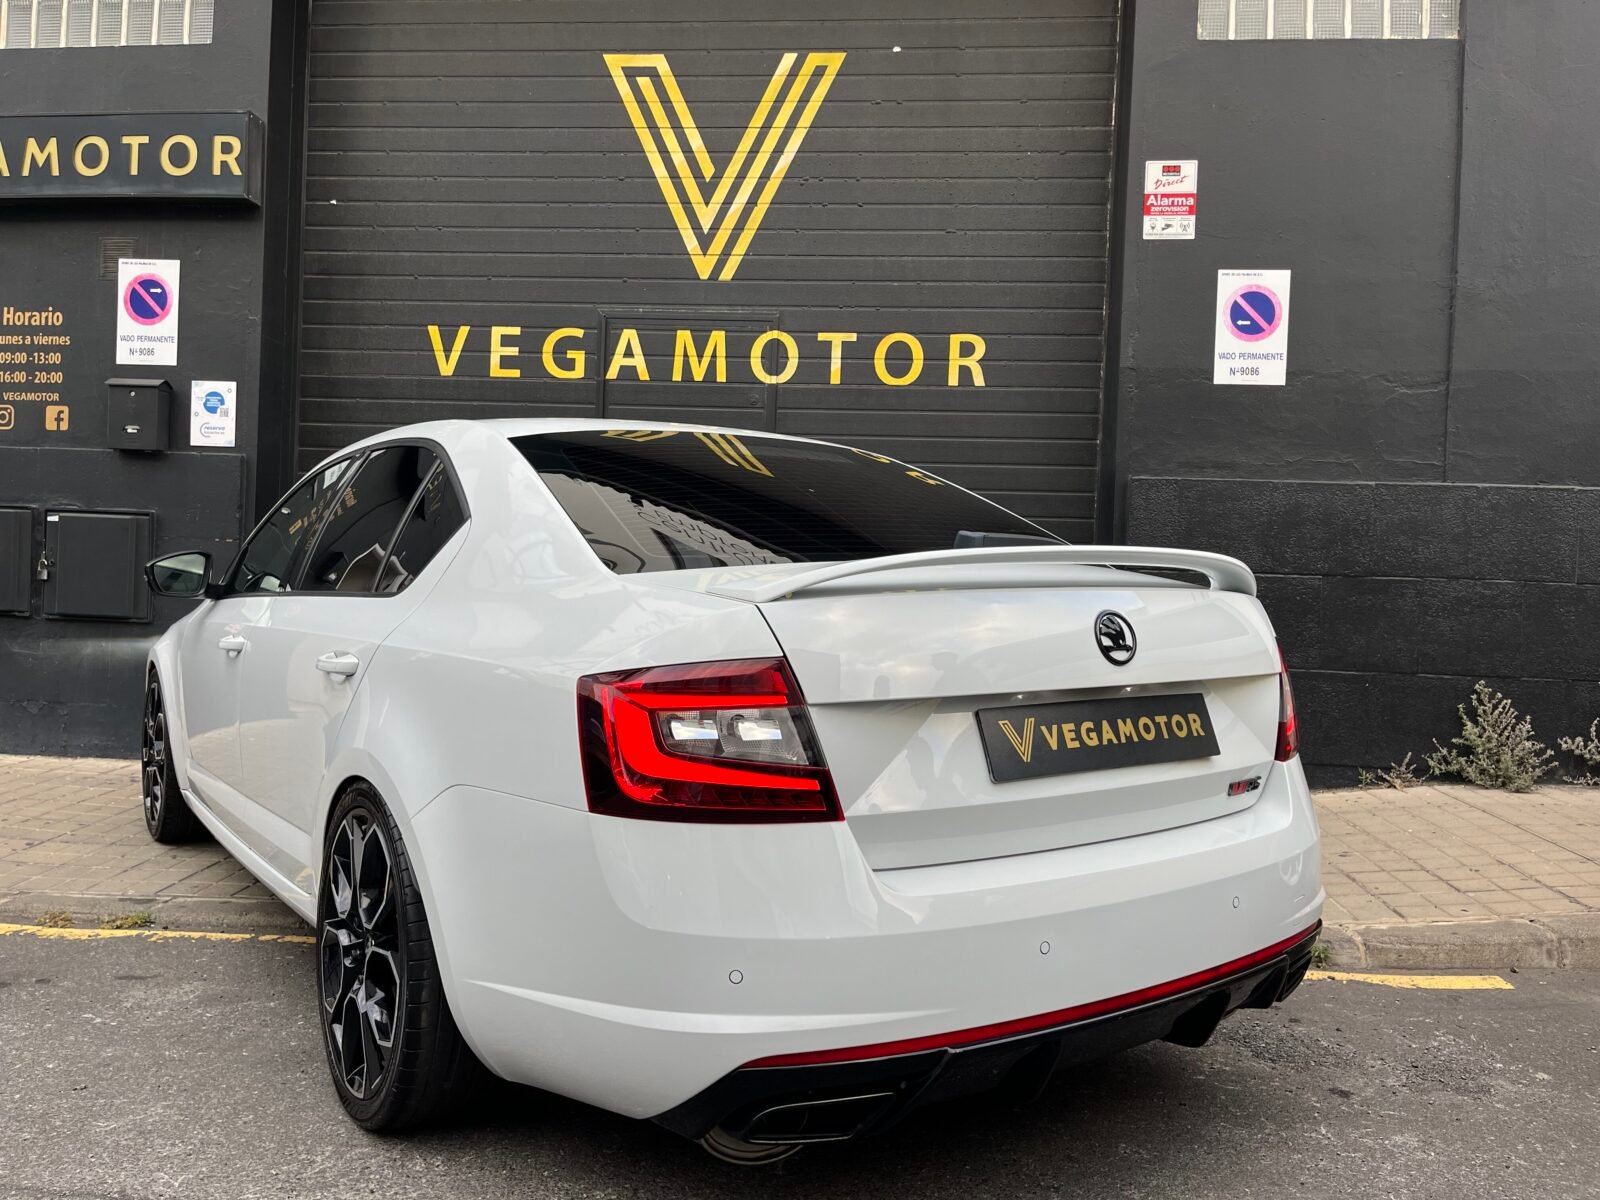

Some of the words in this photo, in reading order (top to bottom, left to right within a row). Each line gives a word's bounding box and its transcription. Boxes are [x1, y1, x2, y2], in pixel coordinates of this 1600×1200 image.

[0, 134, 243, 177] MOTOR
[1147, 194, 1194, 206] Alarma
[2, 306, 63, 326] Horario
[25, 335, 31, 345] a
[33, 332, 71, 345] viernes
[119, 334, 135, 342] VADO
[136, 335, 175, 344] PERMANENTE
[0, 352, 27, 364] 09:00
[427, 324, 987, 387] VEGAMOTOR
[1218, 352, 1236, 360] VADO
[1238, 352, 1285, 361] PERMANENTE
[34, 371, 63, 383] 20:00
[3, 392, 60, 402] VEGAMOTOR
[1040, 712, 1205, 751] VEGAMOTOR
